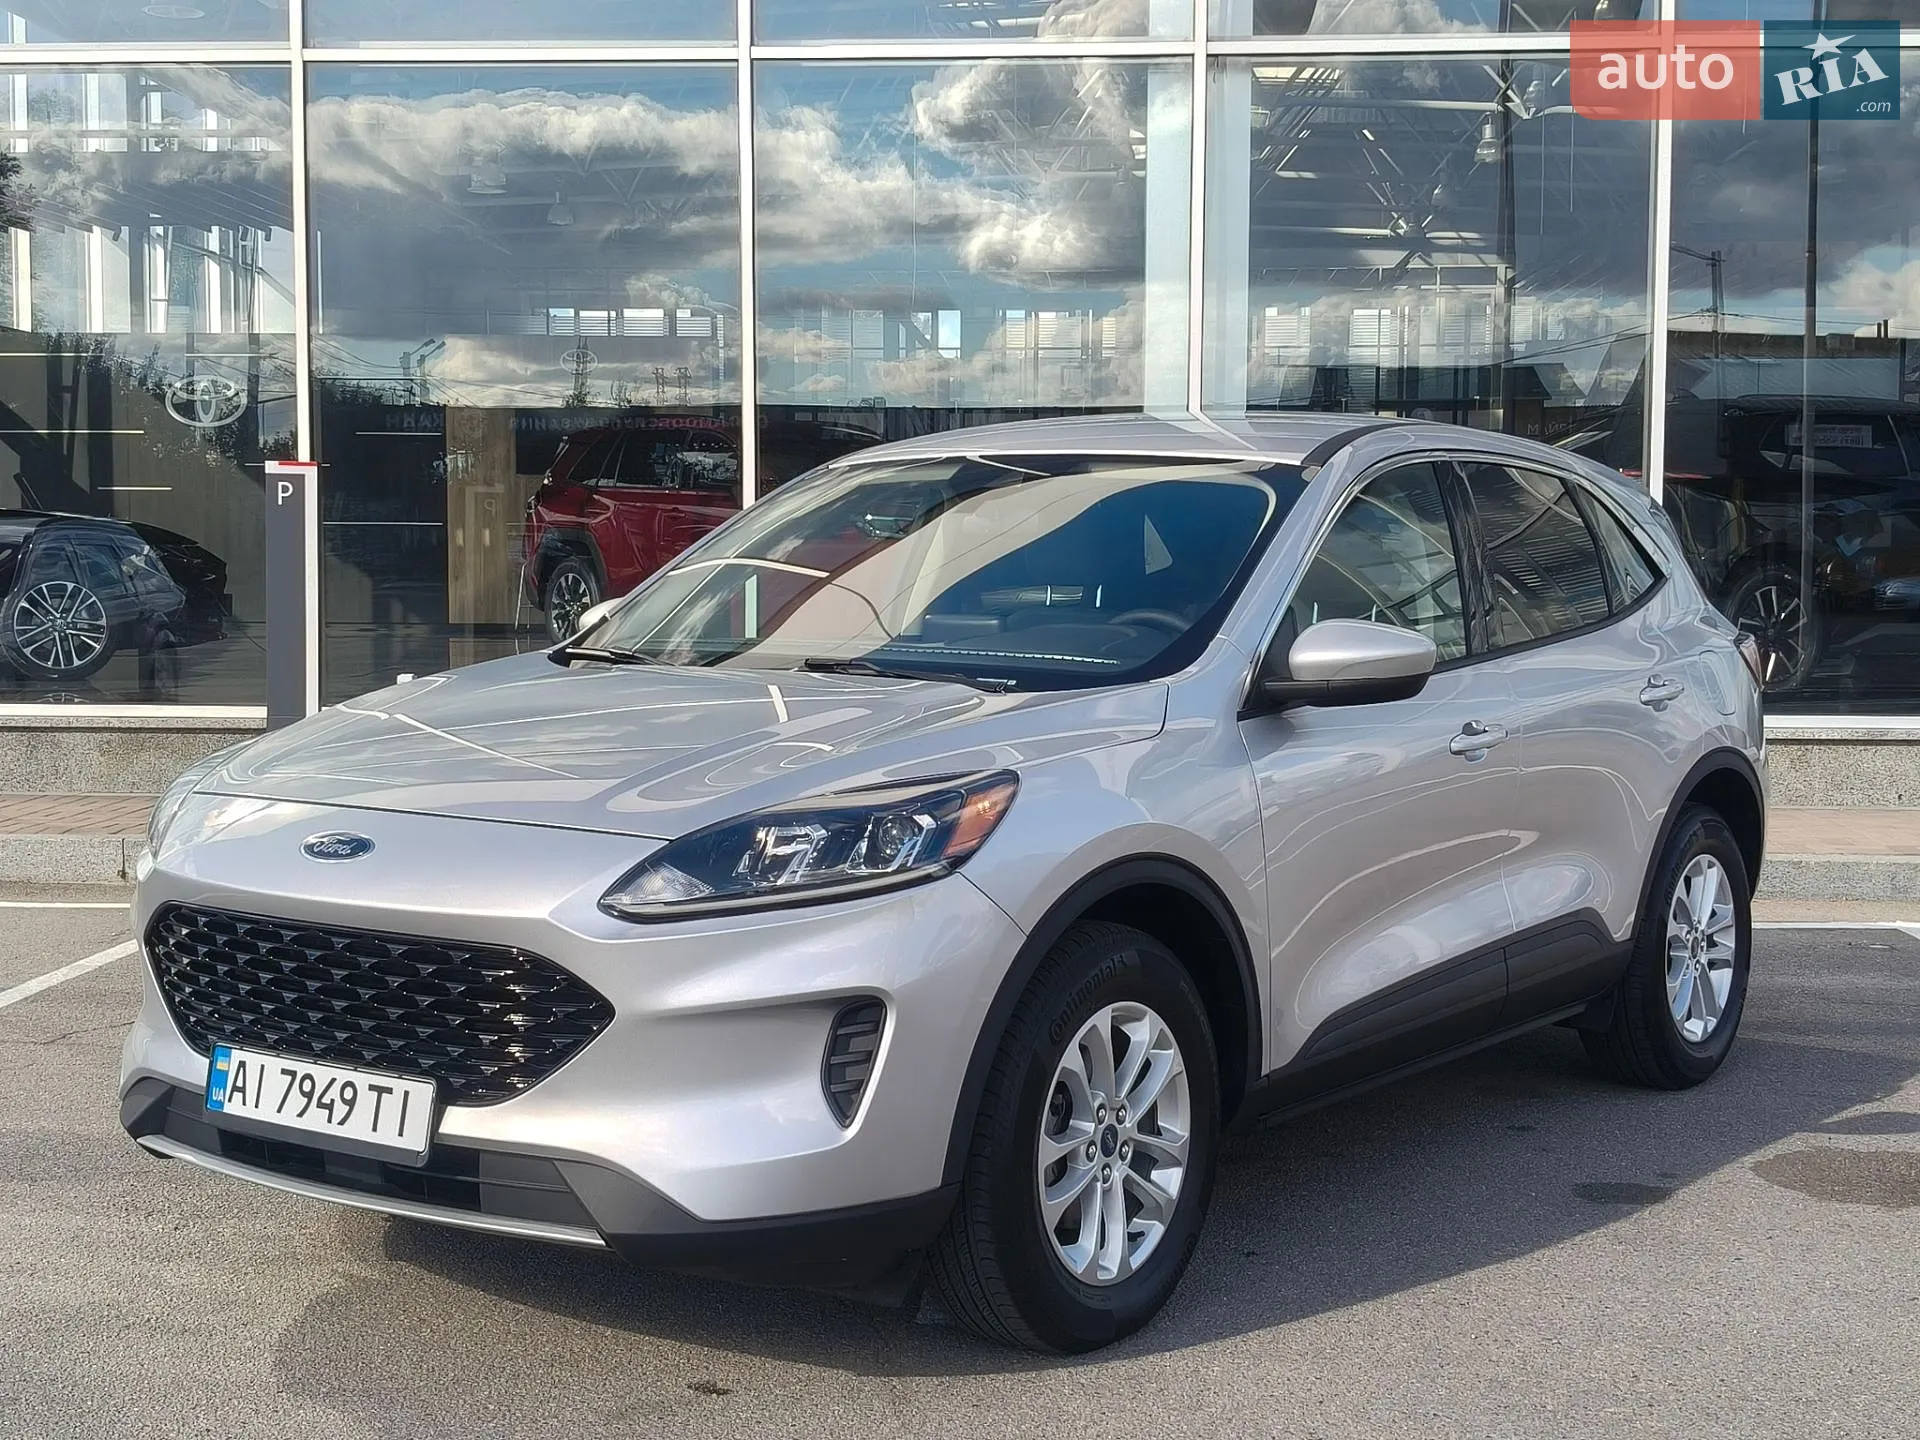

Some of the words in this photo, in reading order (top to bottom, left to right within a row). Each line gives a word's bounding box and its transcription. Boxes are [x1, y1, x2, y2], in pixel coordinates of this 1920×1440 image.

[278, 481, 293, 505] P
[212, 1086, 225, 1103] UA
[227, 1060, 266, 1109] AI
[276, 1067, 359, 1126] 7949
[368, 1083, 410, 1138] TI
